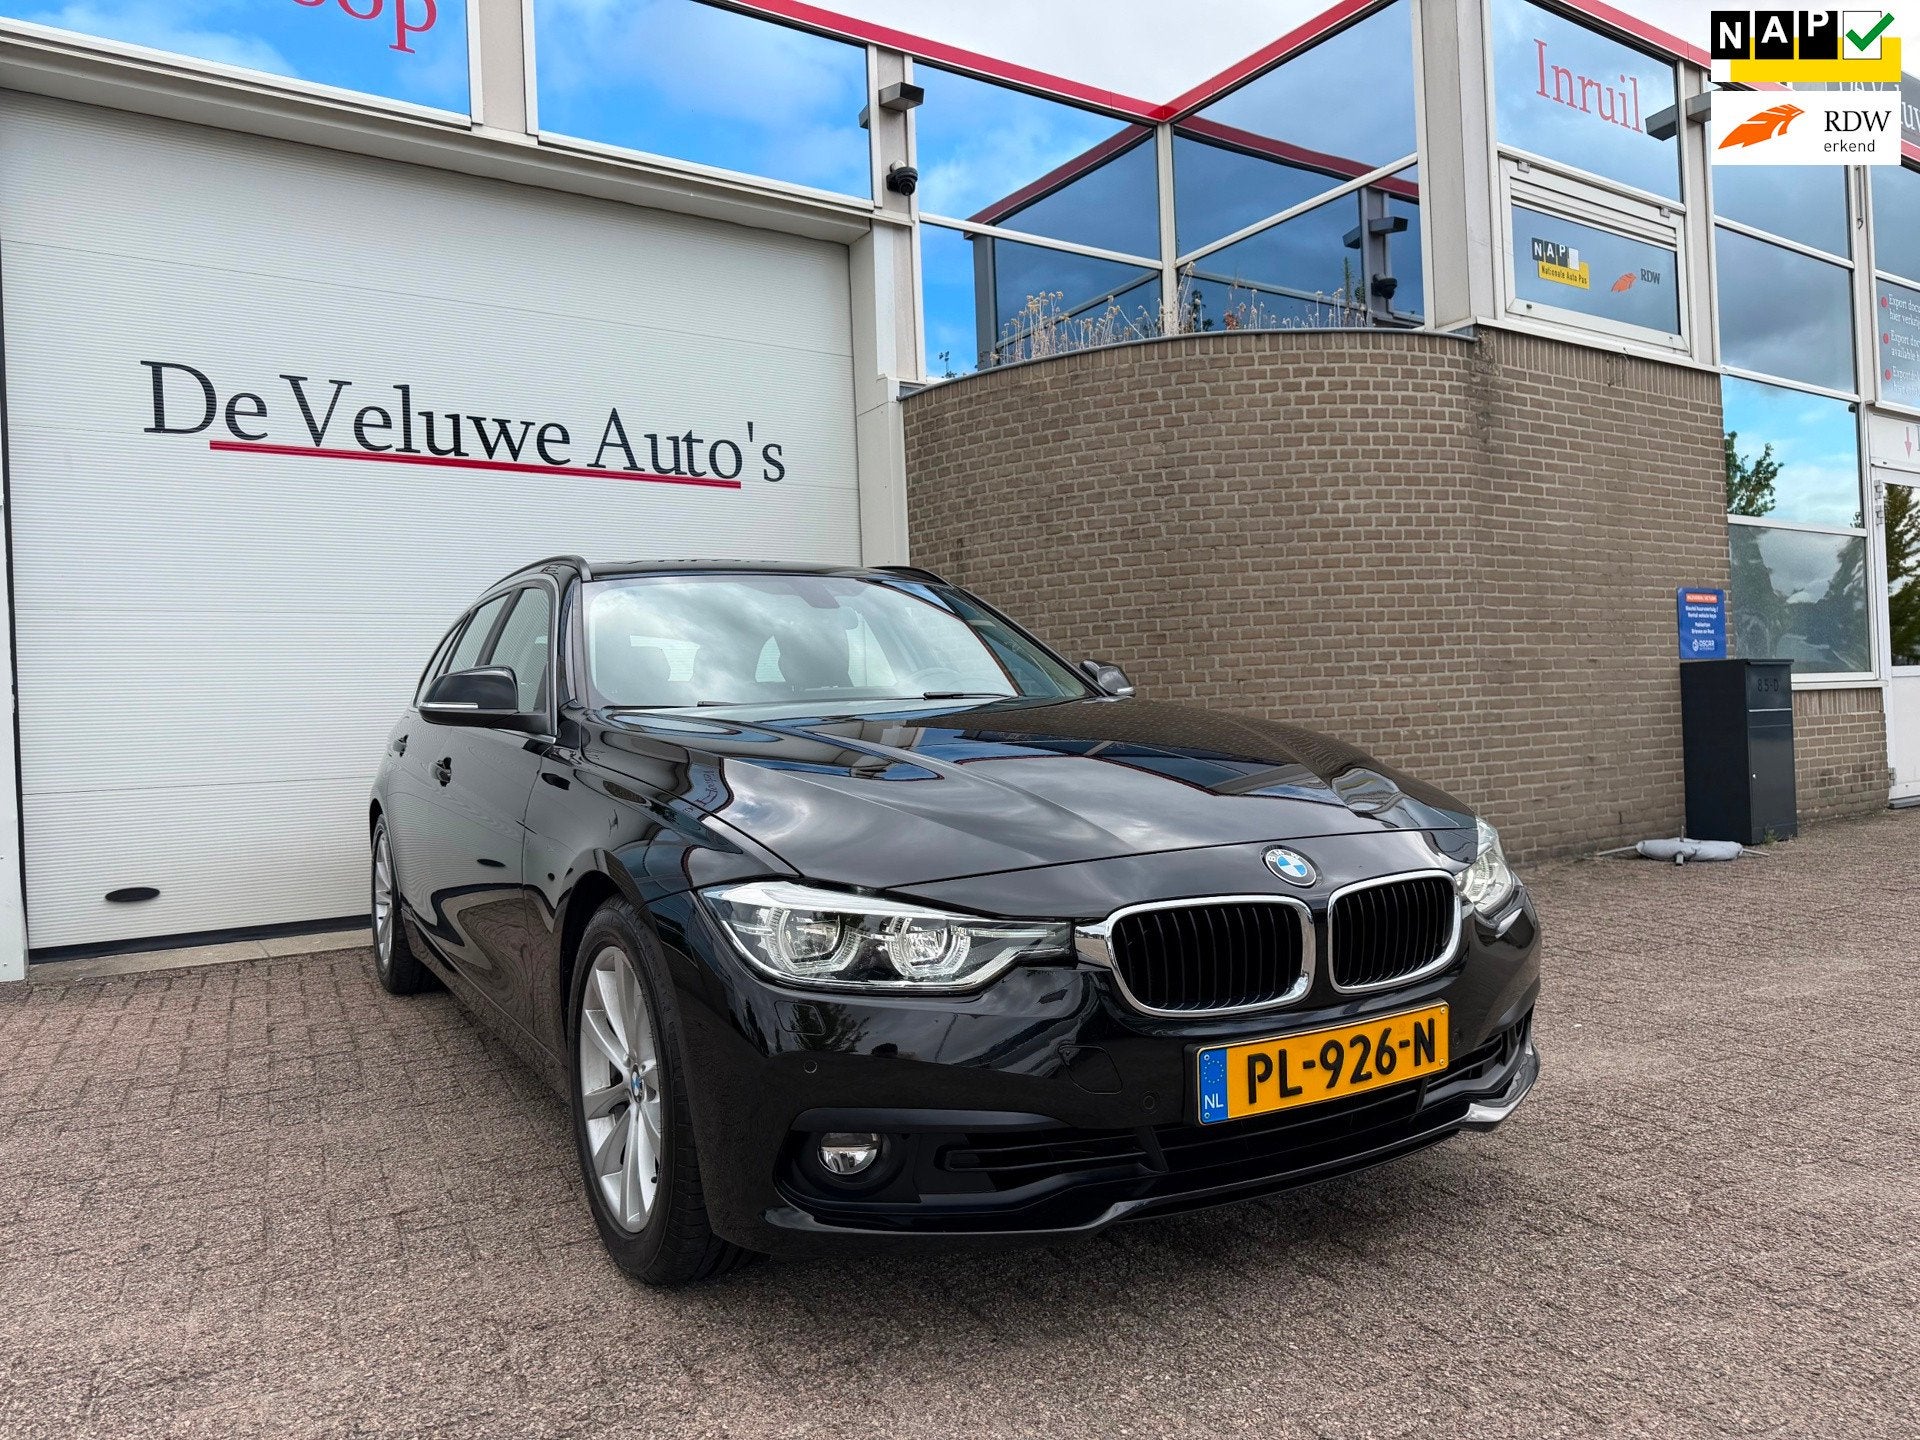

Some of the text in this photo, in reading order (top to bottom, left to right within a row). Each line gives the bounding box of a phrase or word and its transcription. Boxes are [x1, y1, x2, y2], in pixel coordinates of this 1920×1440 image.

[1533, 38, 1643, 133] Inruil
[1534, 241, 1566, 258] NAP
[1640, 268, 1661, 285] RDW
[140, 360, 786, 482] De Veluwe Auto's
[1757, 679, 1779, 692] 85-D
[1204, 1018, 1436, 1109] NL PL-926-N
